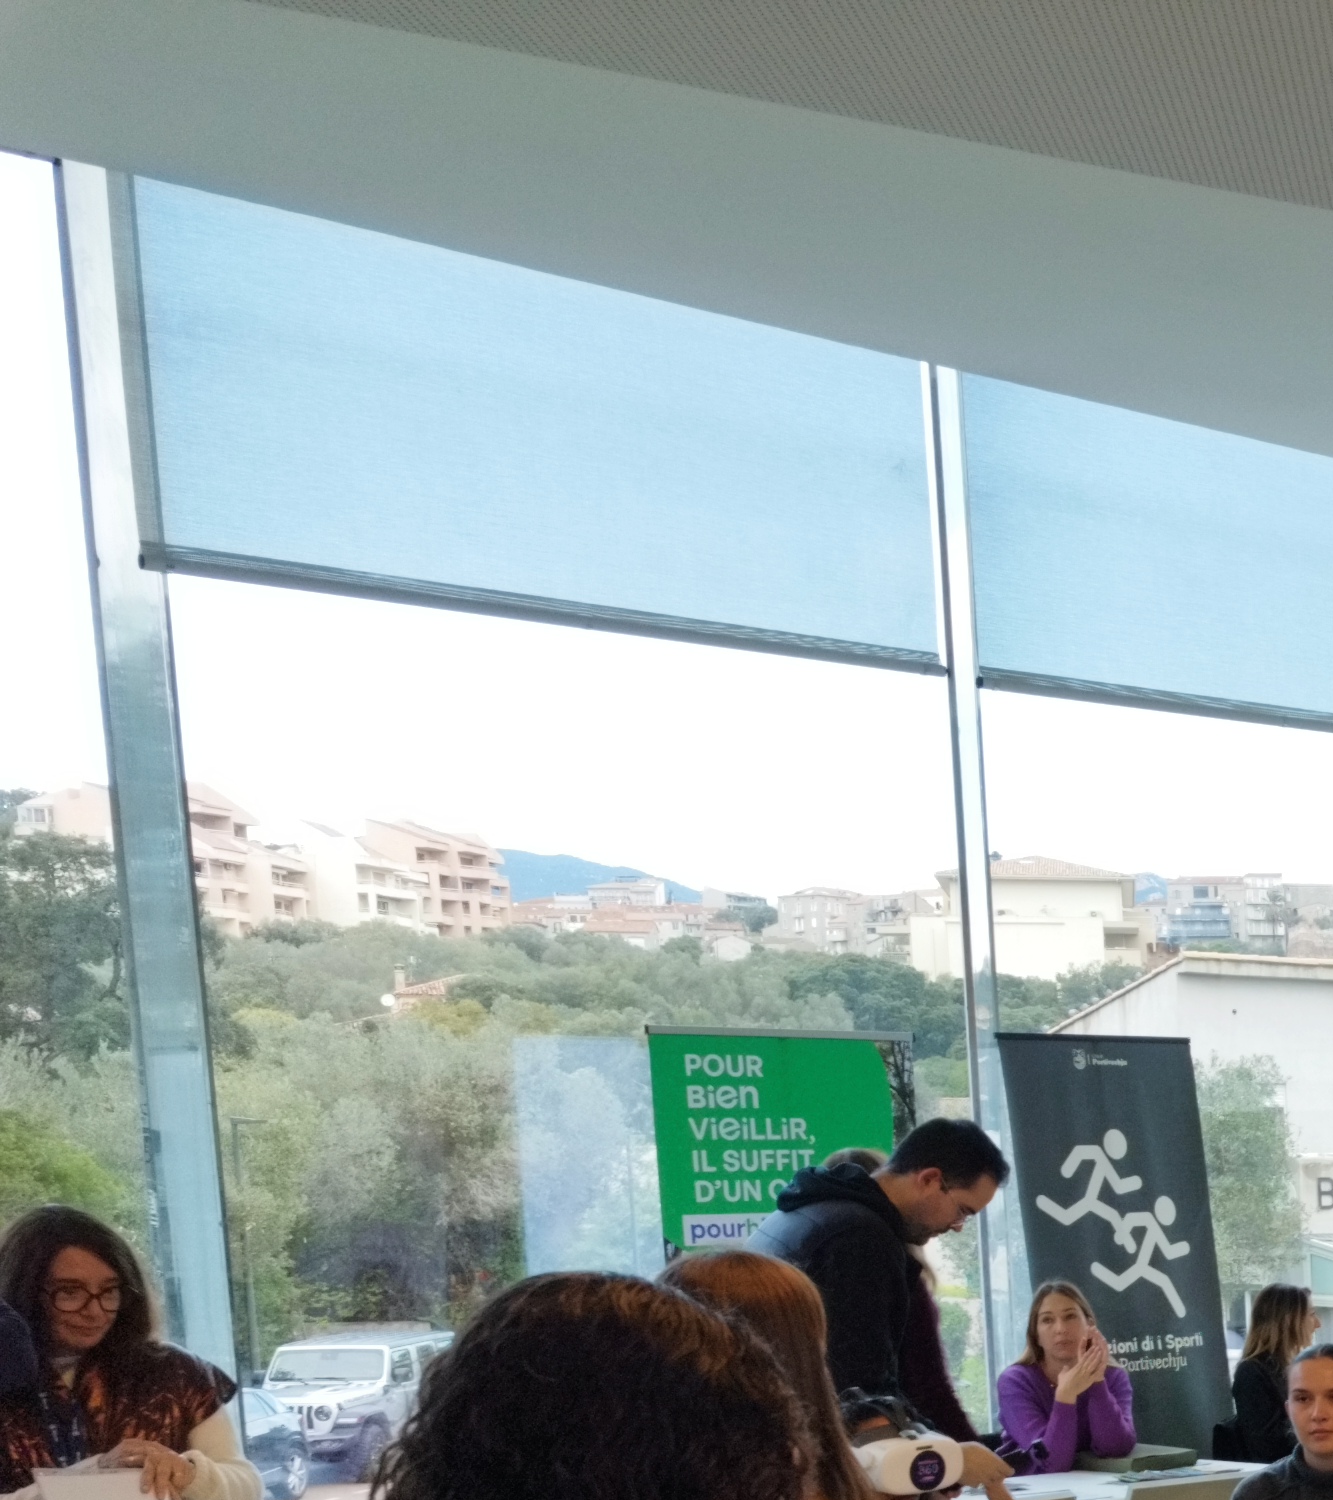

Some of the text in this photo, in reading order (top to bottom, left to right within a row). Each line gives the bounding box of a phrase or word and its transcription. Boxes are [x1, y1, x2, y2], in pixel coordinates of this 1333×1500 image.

[684, 1053, 764, 1079] POUR
[691, 1148, 815, 1173] IL SUFFIT
[1164, 1331, 1204, 1354] Sporti
